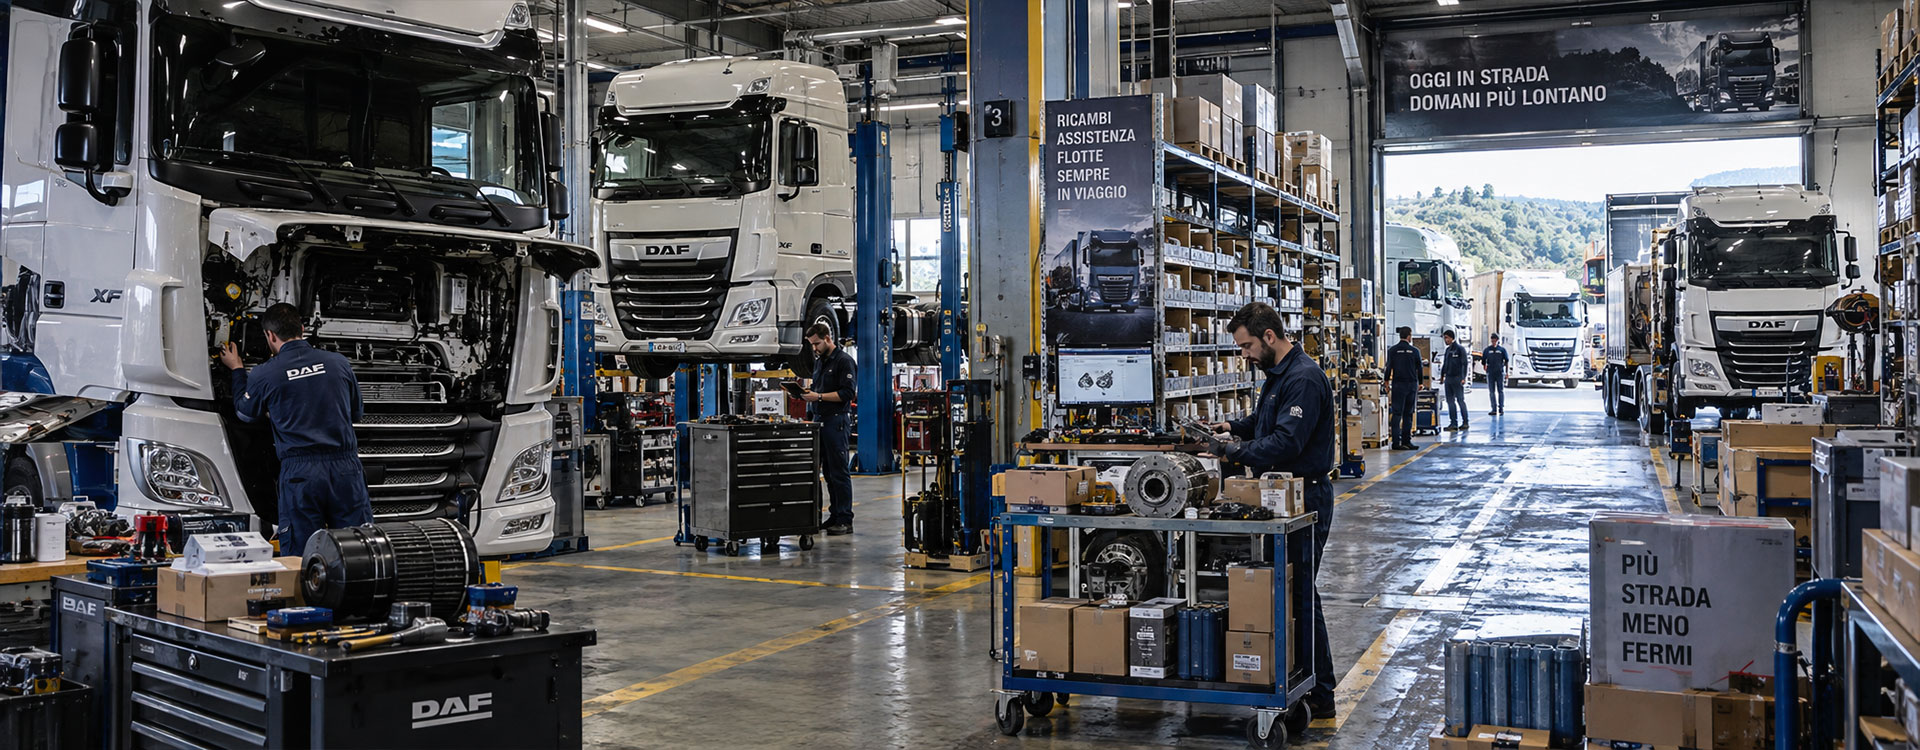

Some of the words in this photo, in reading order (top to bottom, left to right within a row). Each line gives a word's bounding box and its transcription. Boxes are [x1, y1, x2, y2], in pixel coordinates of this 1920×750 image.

[1409, 71, 1450, 89] OGGI
[1457, 70, 1474, 87] IN
[1480, 65, 1549, 85] STRADA
[1410, 92, 1480, 111] DOMANI
[1487, 86, 1516, 107] PIÙ
[1522, 85, 1607, 106] LONTANO
[991, 108, 1002, 127] 3
[1057, 111, 1112, 127] RICAMBI
[1057, 128, 1136, 145] ASSISTENZA
[1057, 149, 1103, 164] FLOTTE
[1057, 167, 1110, 182] SEMPRE
[1057, 187, 1071, 201] IN
[1074, 185, 1127, 200] VIAGGIO
[645, 244, 690, 256] DAF
[778, 241, 793, 249] XF
[90, 288, 123, 304] XF
[1748, 320, 1786, 329] DAF
[286, 363, 325, 378] DAF
[1622, 550, 1658, 576] PIÙ
[1621, 583, 1712, 608] STRADA
[1622, 612, 1690, 637] MENO
[1622, 641, 1692, 666] FERMI
[412, 692, 492, 720] DAF
